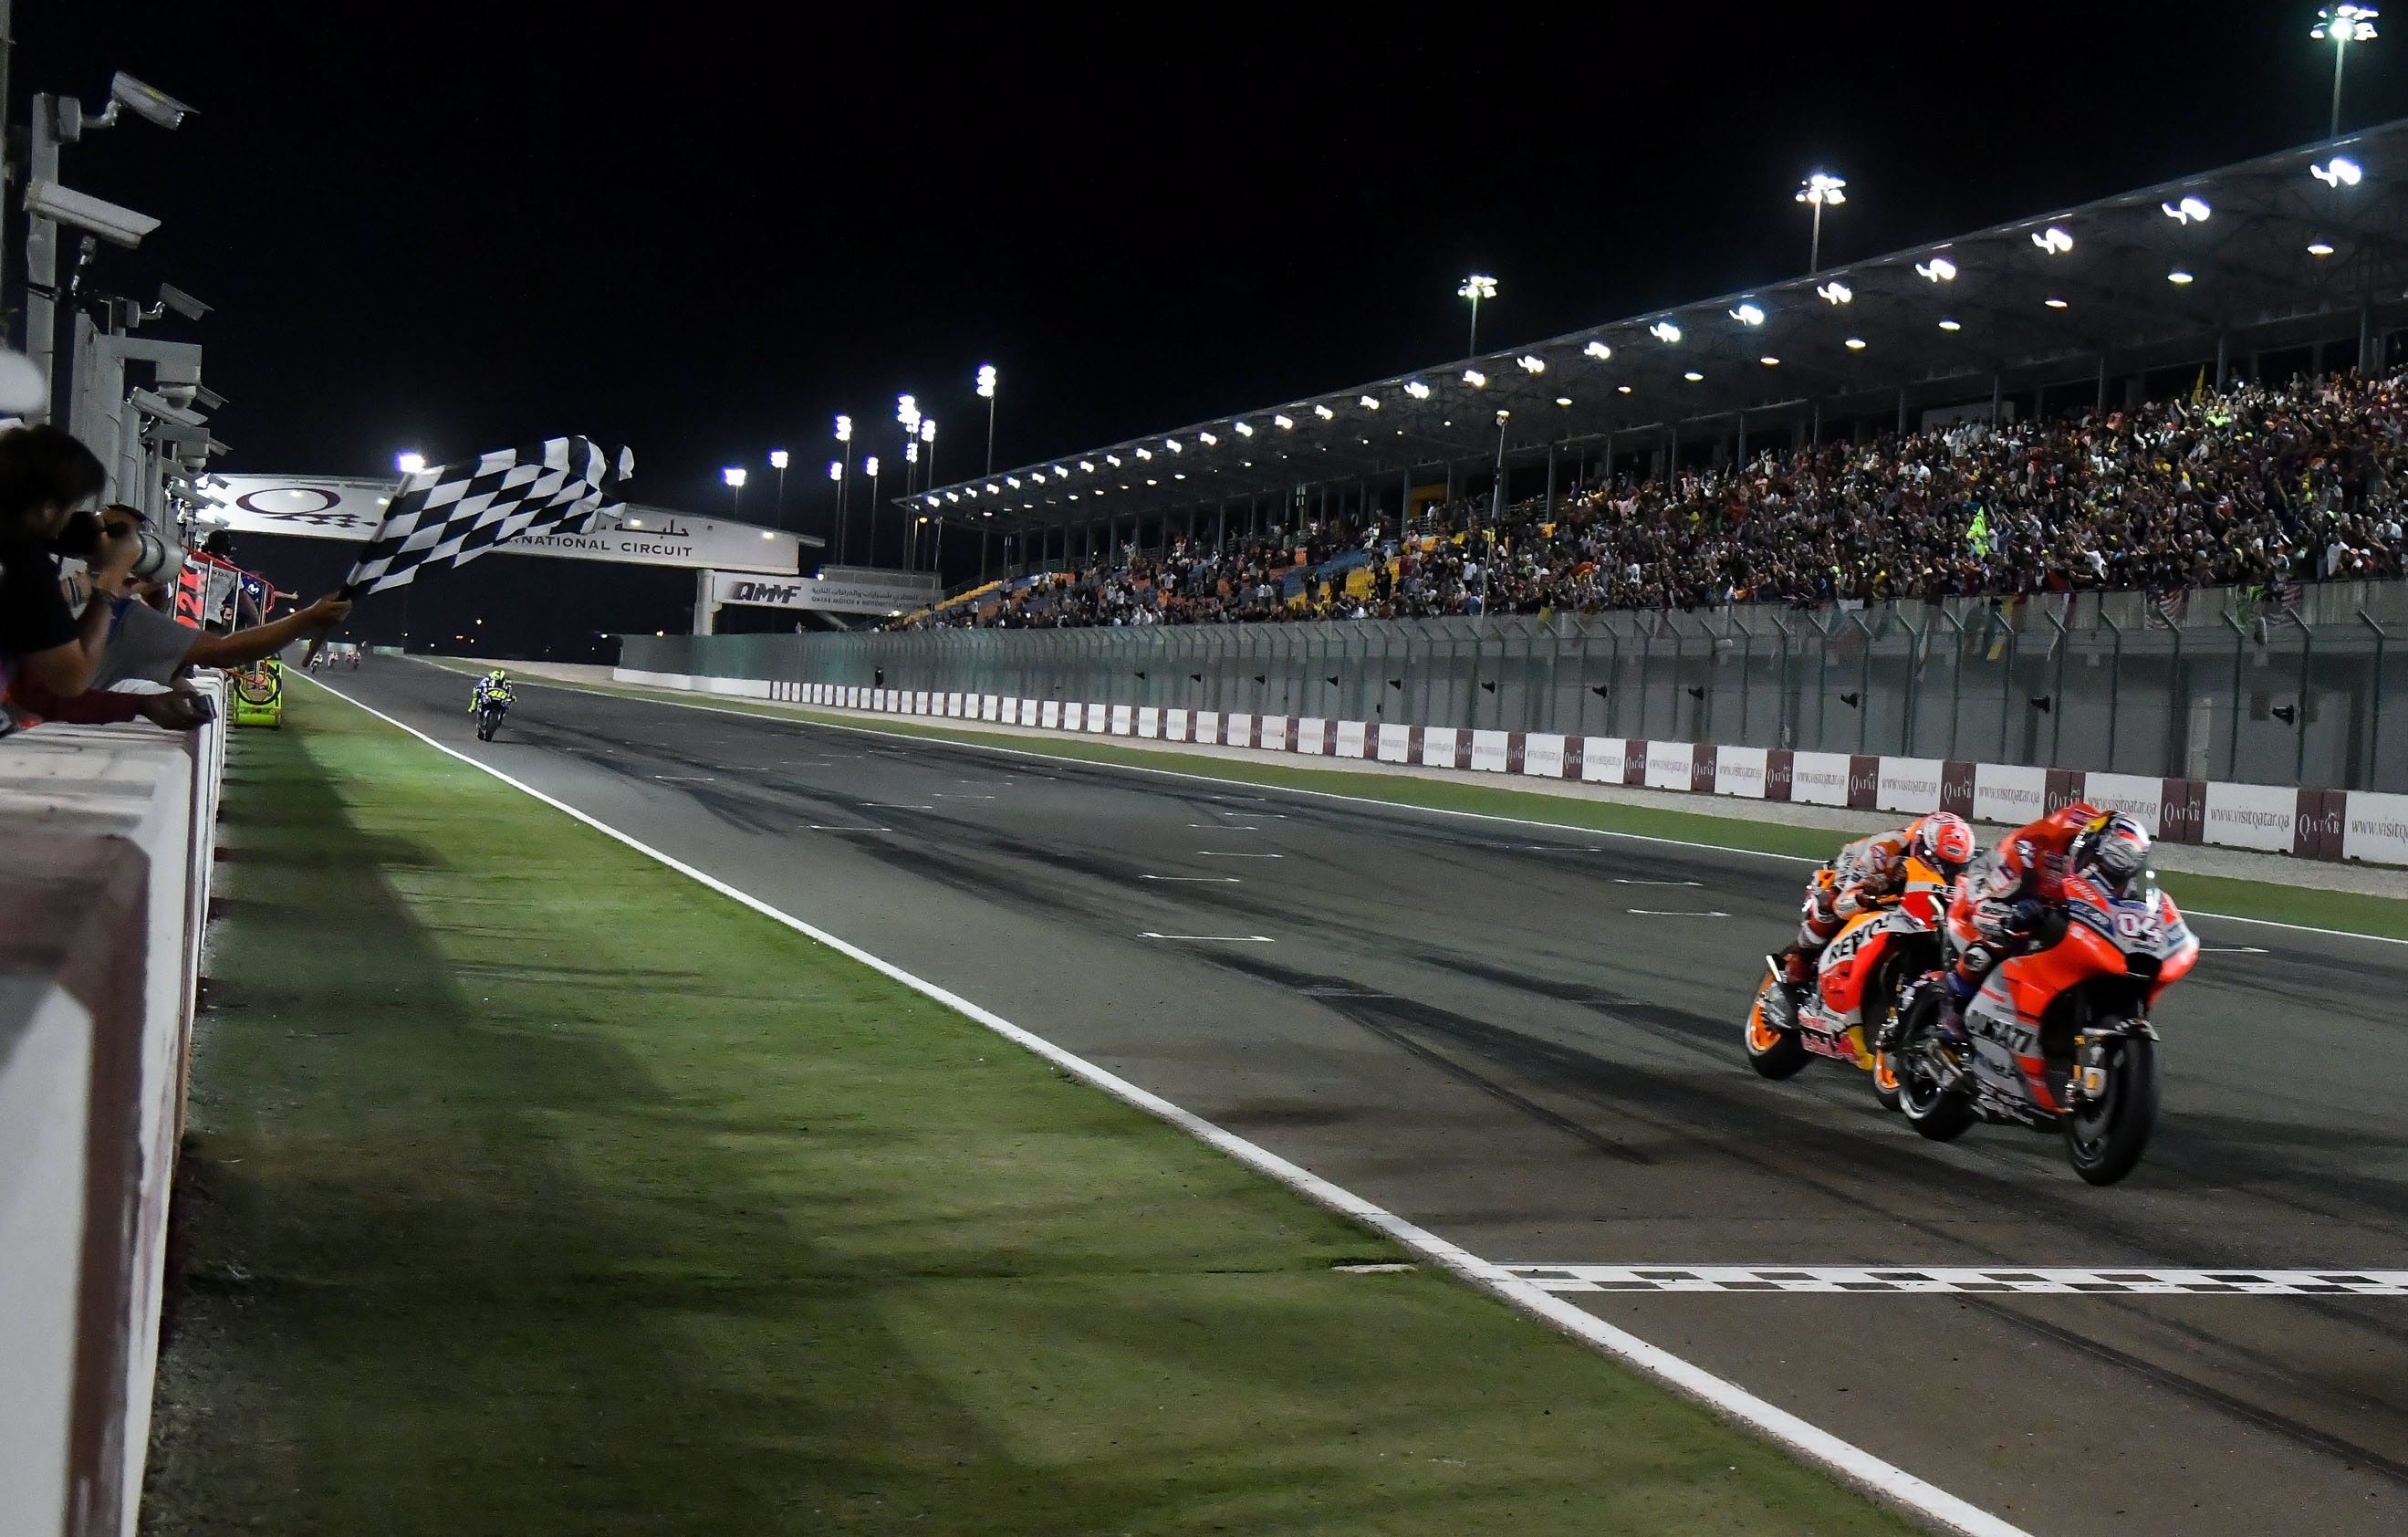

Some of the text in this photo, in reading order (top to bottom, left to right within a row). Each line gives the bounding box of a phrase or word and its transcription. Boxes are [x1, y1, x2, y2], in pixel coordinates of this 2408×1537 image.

[620, 542, 693, 557] CIRCUIT
[732, 581, 802, 604] QMMF
[487, 690, 508, 699] 46
[2164, 802, 2200, 831] QATAR
[2210, 805, 2290, 831] www.visitqatar.qa
[2299, 812, 2340, 842] QATAR
[2117, 912, 2163, 943] 04
